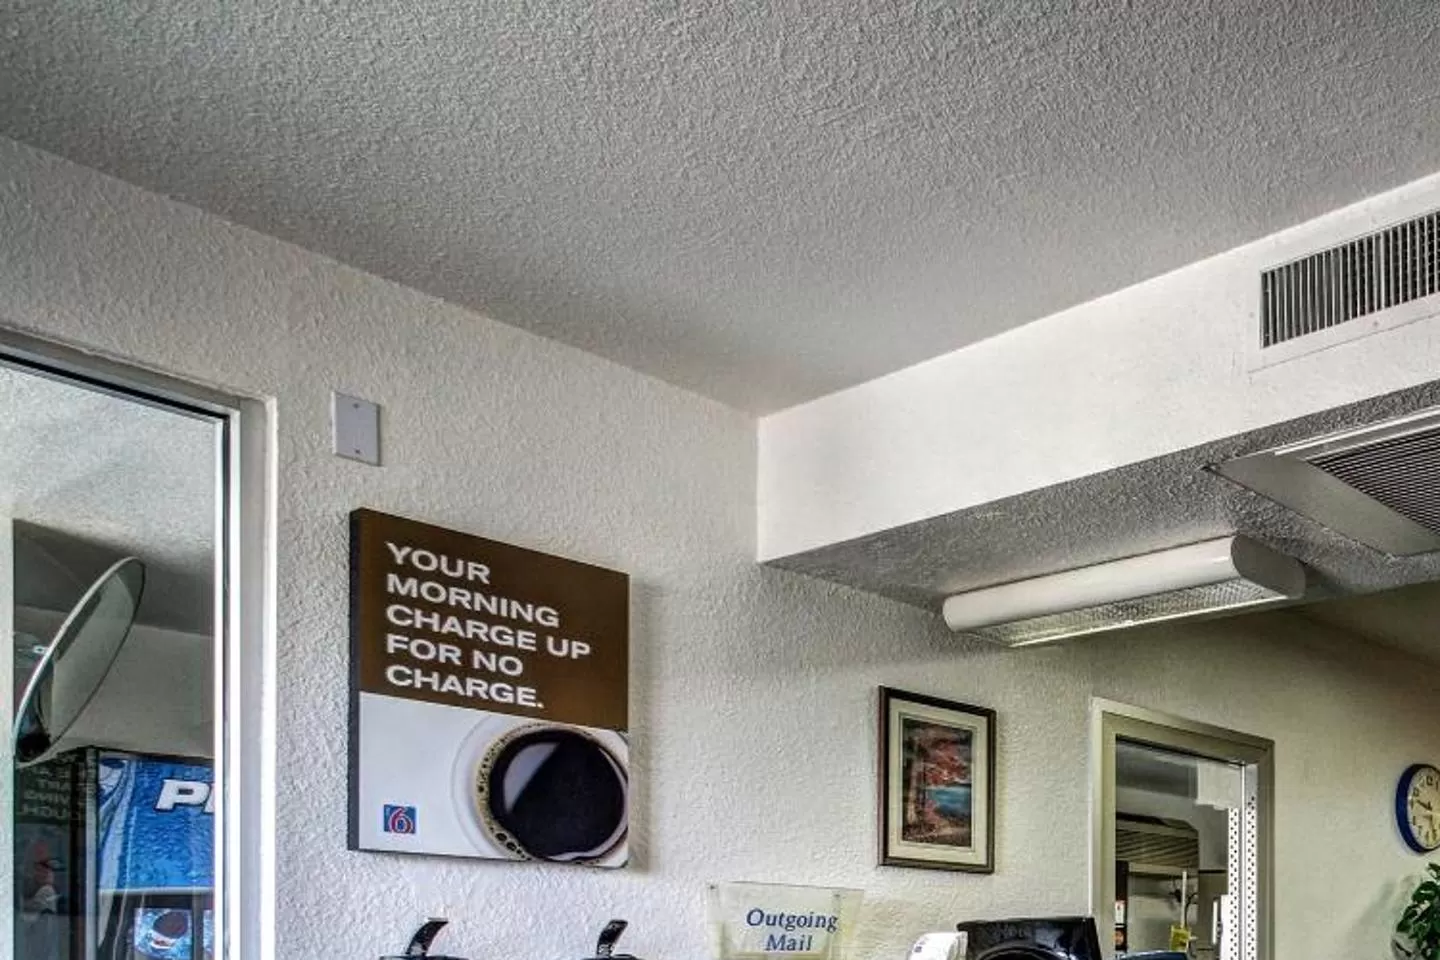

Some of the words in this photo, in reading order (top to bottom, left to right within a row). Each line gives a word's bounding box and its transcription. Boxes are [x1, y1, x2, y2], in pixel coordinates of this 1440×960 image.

[385, 542, 491, 584] YOUR
[385, 573, 560, 628] MORNING
[385, 604, 537, 651] CHARGE
[546, 636, 591, 660] UP
[385, 634, 462, 665] FOR
[472, 649, 524, 677] NO
[385, 664, 545, 709] CHARGE.
[746, 907, 839, 933] Outgoing
[765, 934, 813, 952] Mail
